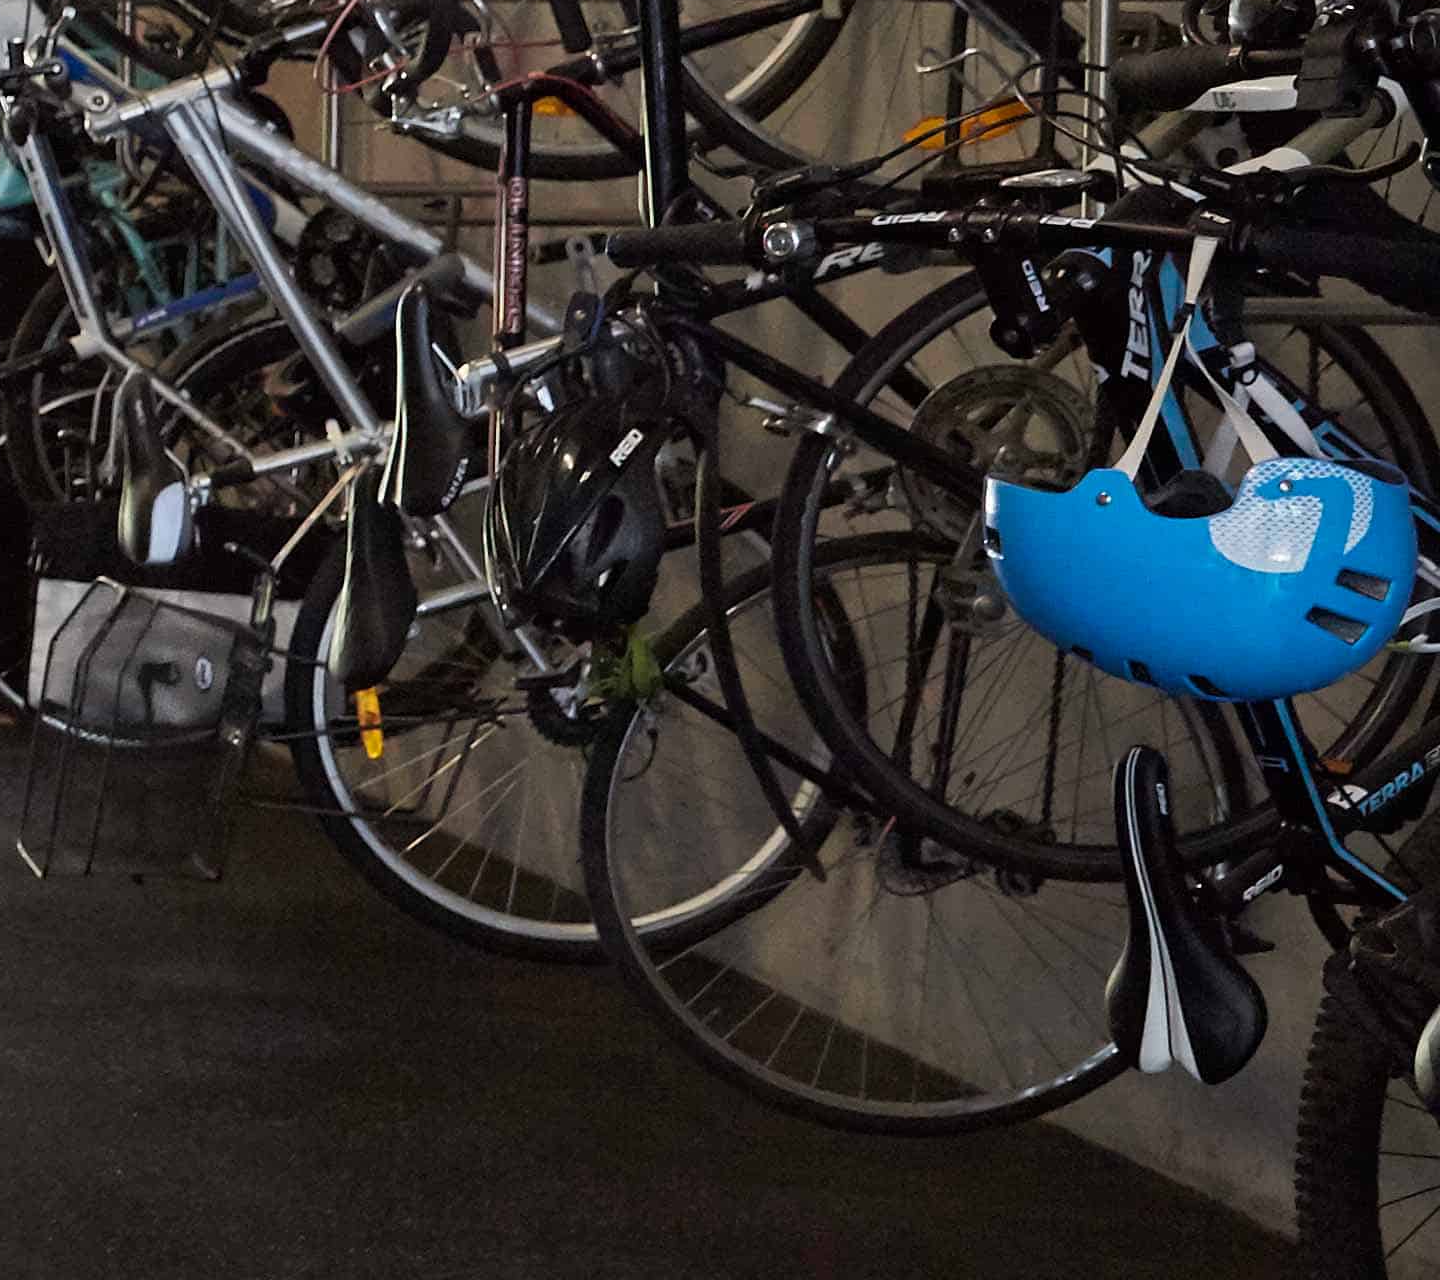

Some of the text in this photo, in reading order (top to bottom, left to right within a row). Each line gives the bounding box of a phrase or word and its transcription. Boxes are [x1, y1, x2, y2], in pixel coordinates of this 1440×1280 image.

[812, 242, 887, 279] RE
[1022, 259, 1050, 312] REID
[1120, 249, 1153, 381] TERR
[1359, 761, 1425, 817] TERRA
